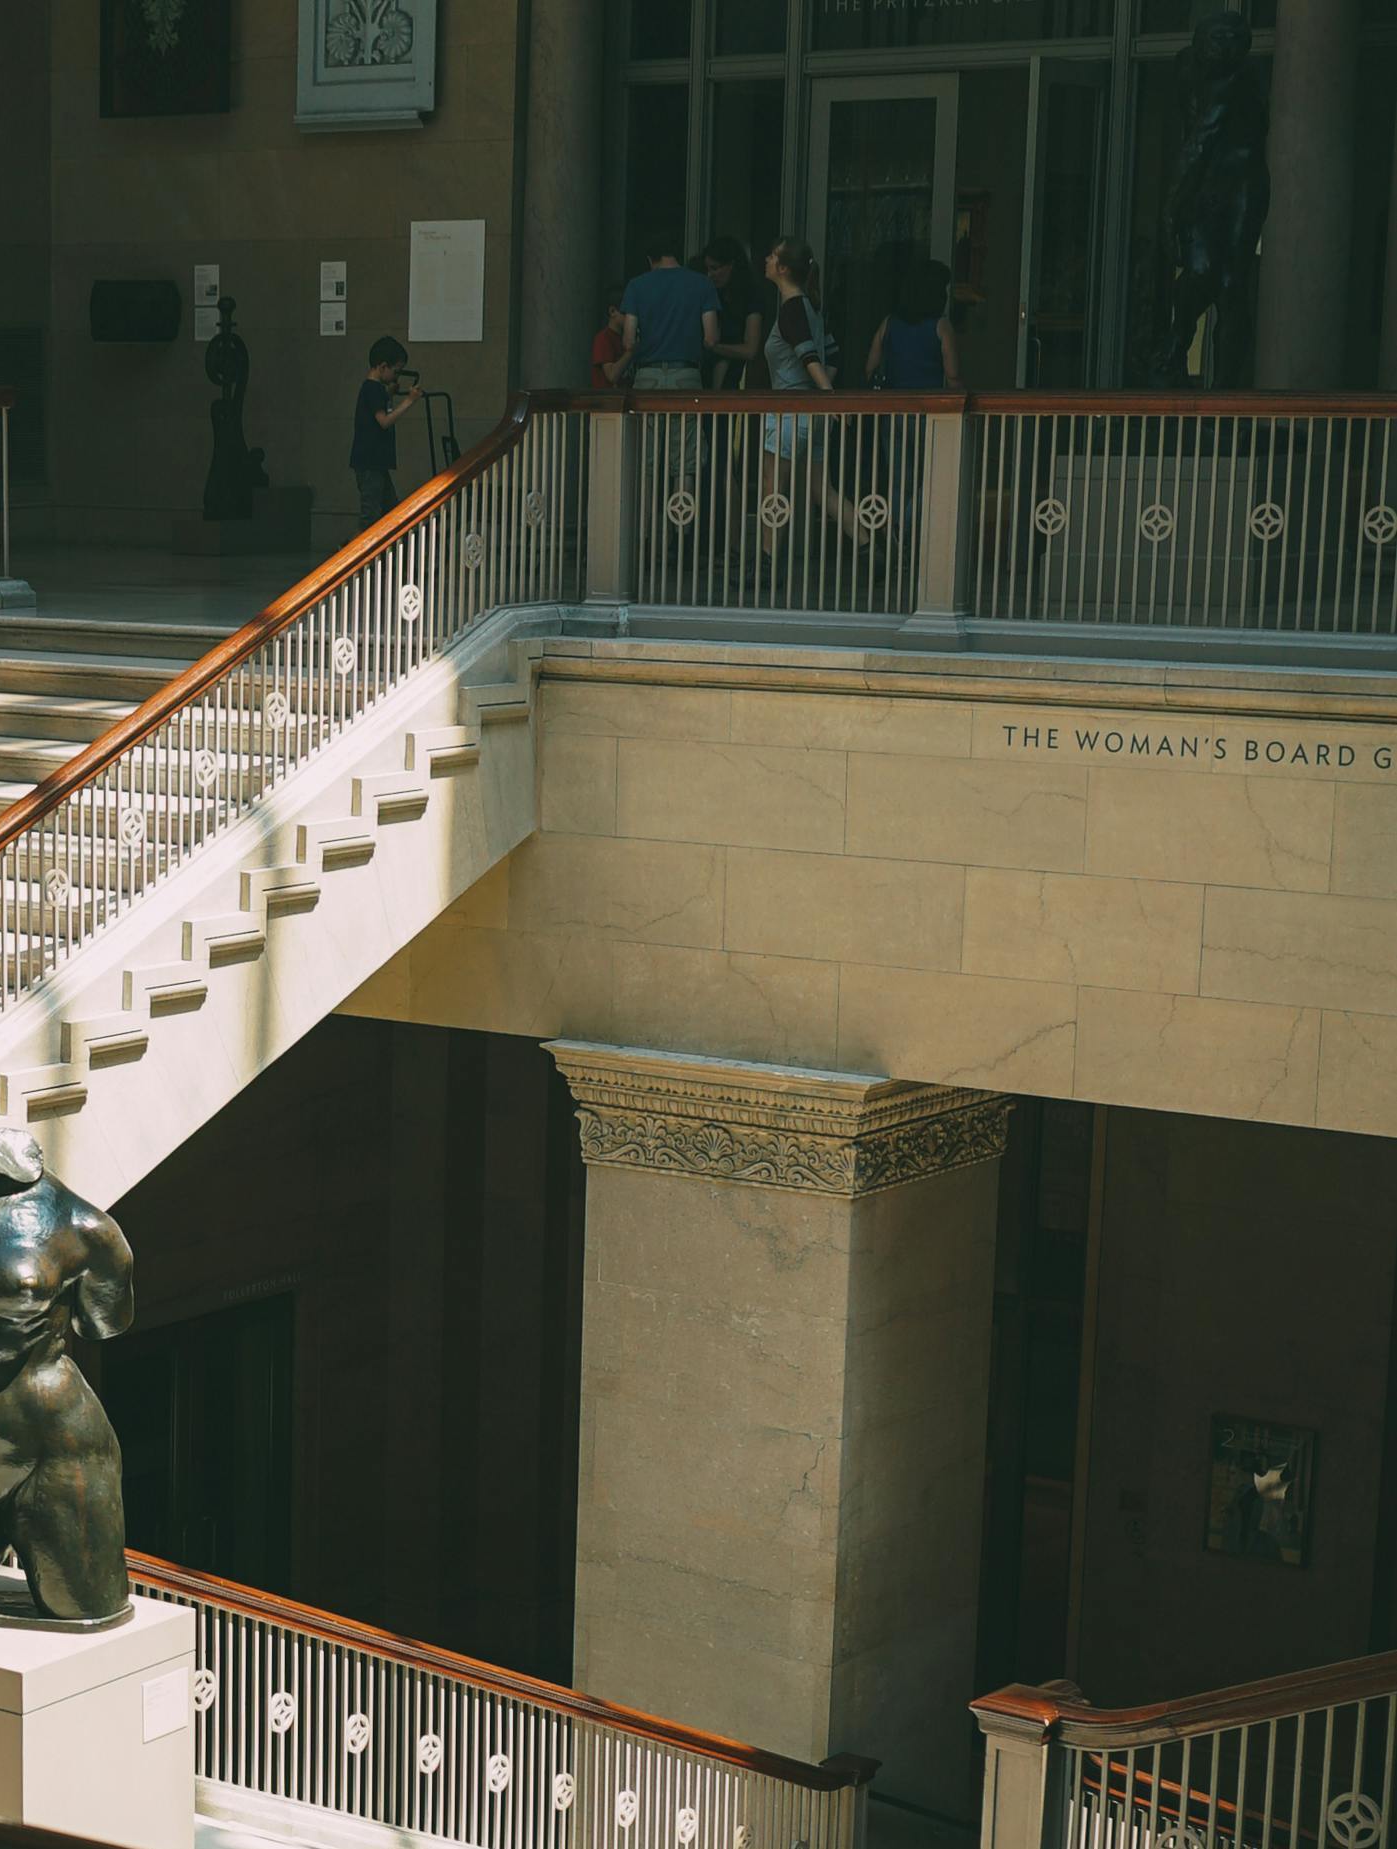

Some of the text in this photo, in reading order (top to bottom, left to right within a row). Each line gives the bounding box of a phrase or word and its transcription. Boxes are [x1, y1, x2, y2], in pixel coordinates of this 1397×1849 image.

[873, 0, 978, 10] PRIT
[1003, 725, 1392, 769] THE WOMAN'S BOARD G
[1220, 1428, 1236, 1448] 2
